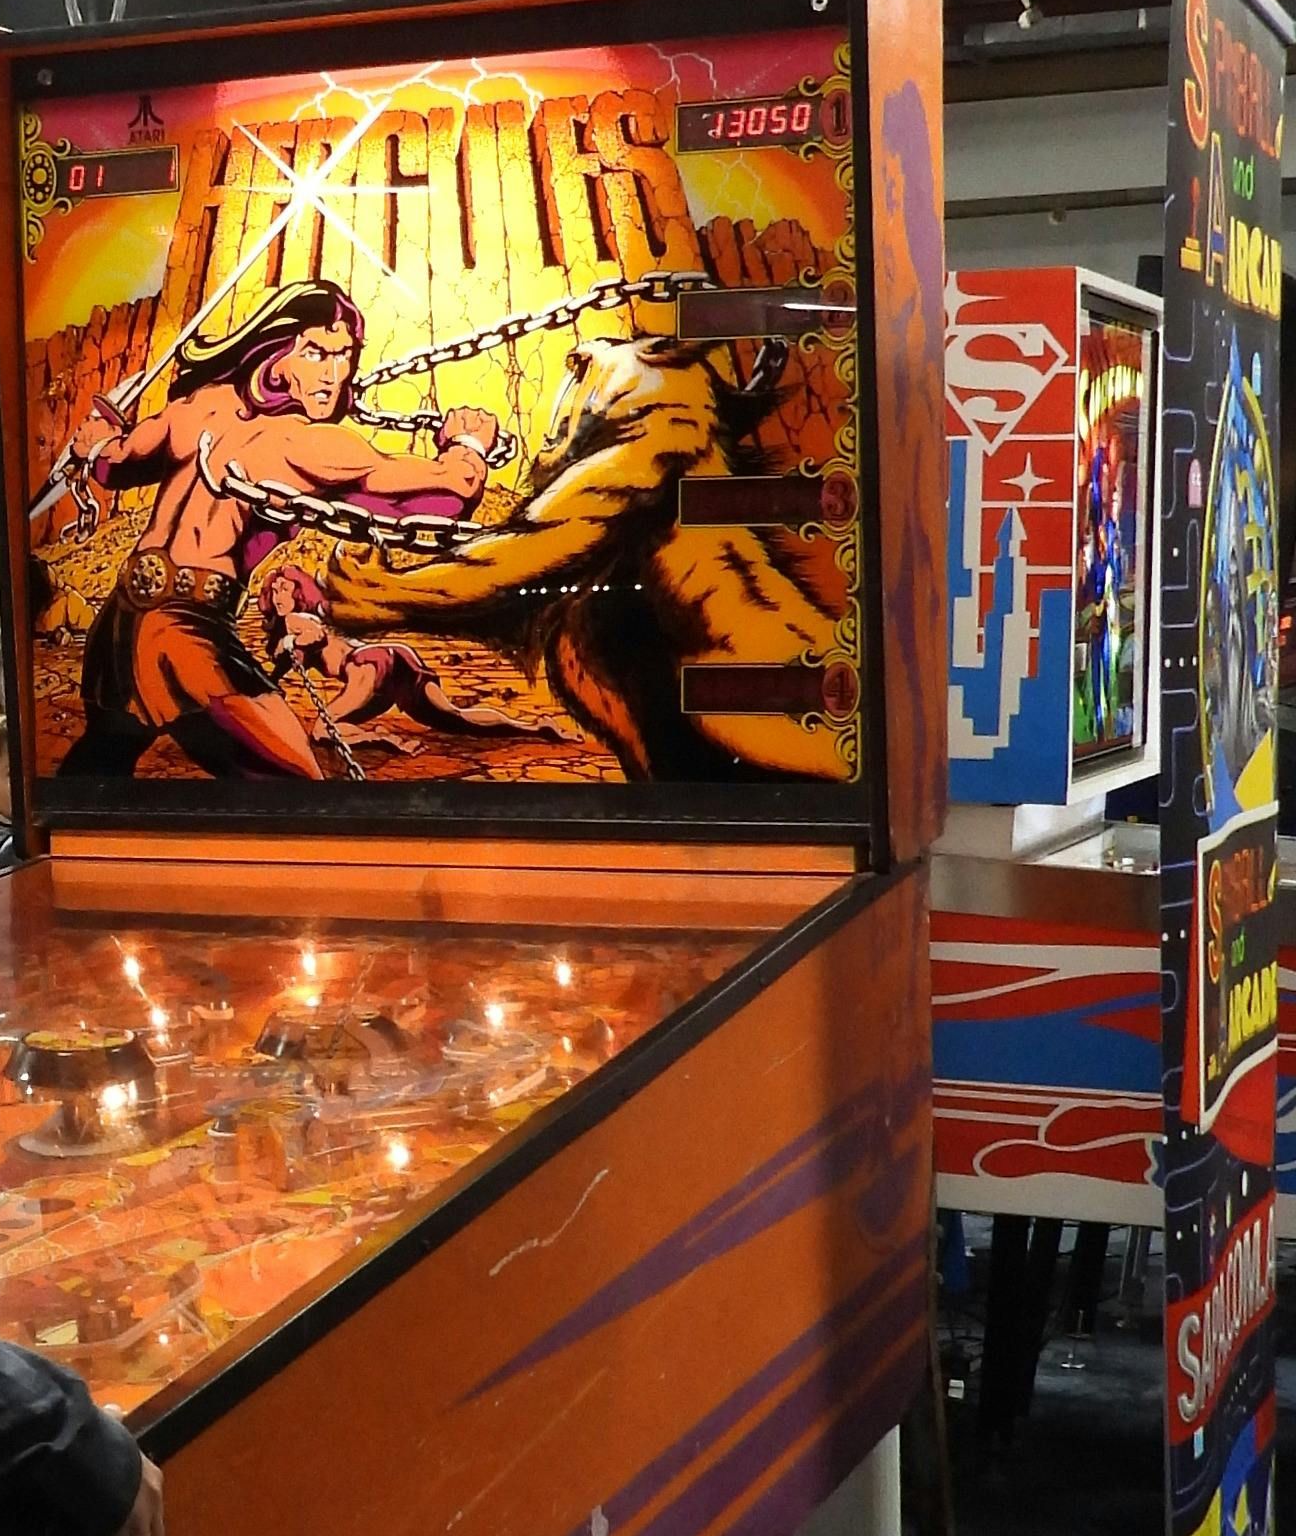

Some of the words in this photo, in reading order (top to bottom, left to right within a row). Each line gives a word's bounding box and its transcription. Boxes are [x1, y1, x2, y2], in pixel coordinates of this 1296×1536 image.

[128, 129, 165, 145] ATARI
[713, 102, 811, 140] 13050
[169, 86, 702, 304] HERCULES
